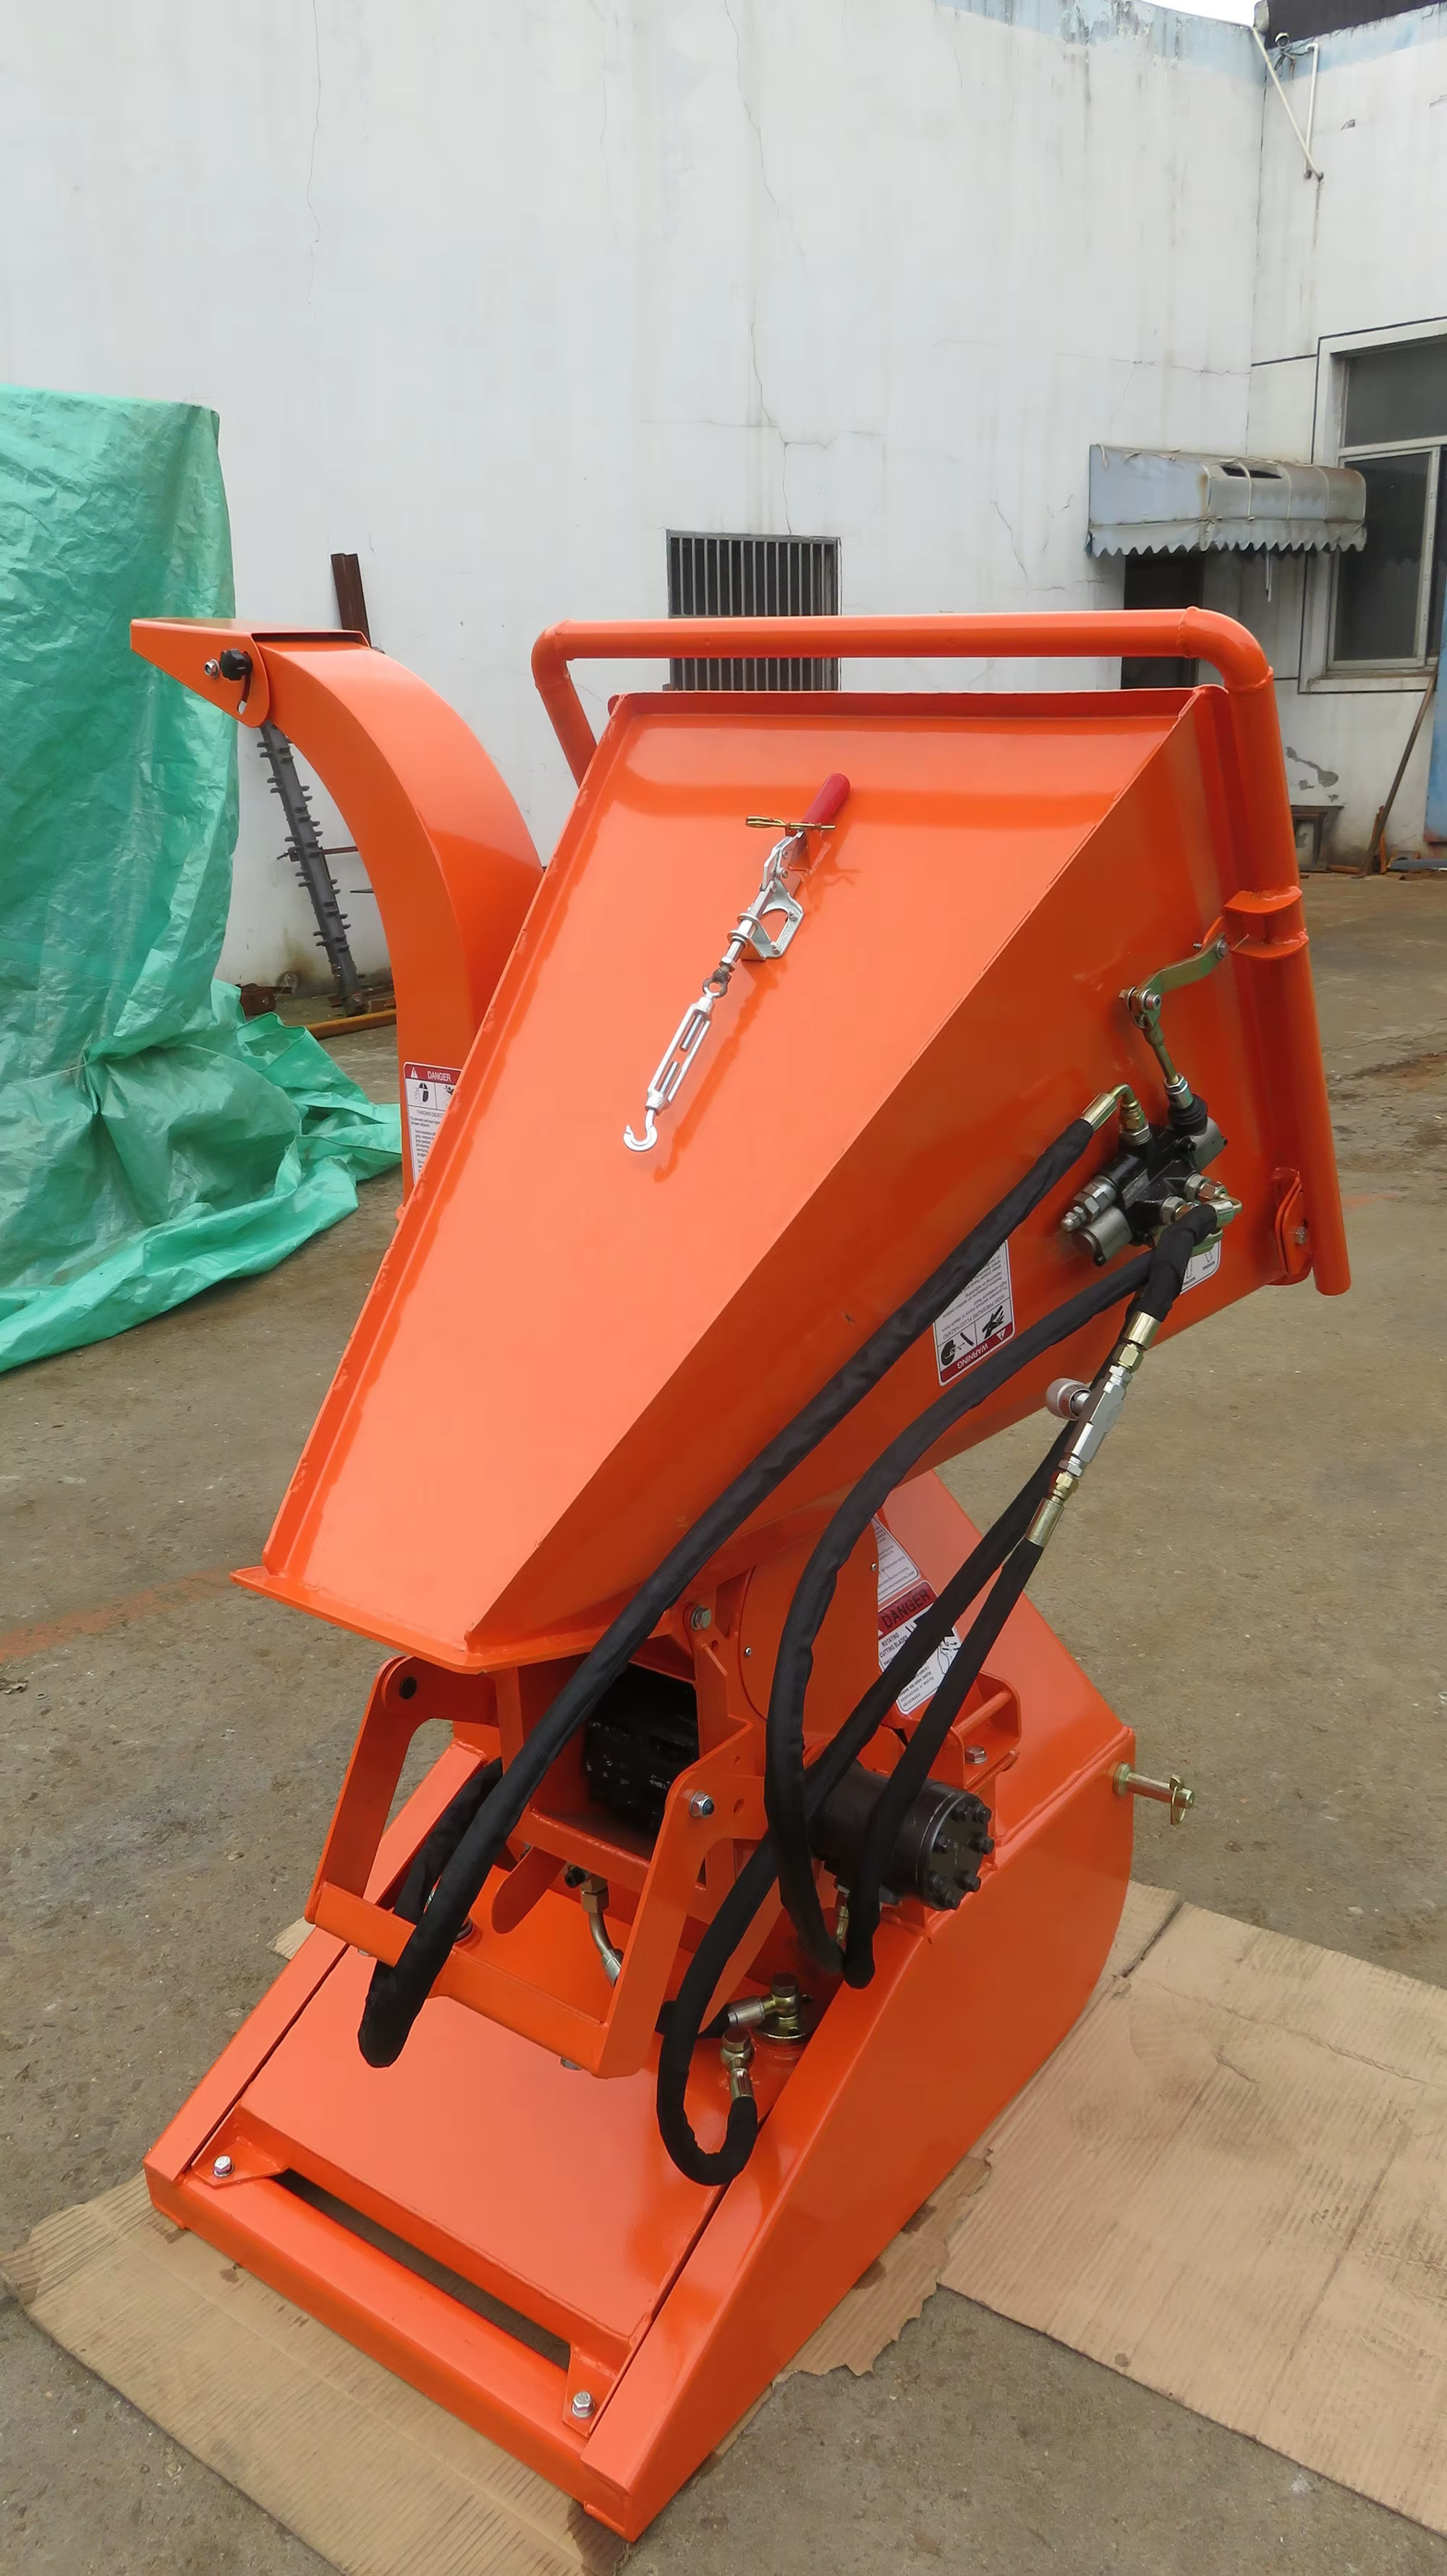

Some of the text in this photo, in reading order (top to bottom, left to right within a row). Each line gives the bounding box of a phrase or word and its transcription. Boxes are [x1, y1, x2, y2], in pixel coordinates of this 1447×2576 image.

[427, 1070, 451, 1082] DANGER
[972, 1301, 993, 1319] PRESSURE
[959, 1316, 972, 1328] FLUID
[942, 1325, 959, 1340] HAZARD
[956, 1342, 988, 1369] WARNING
[882, 1589, 931, 1629] DANGER
[881, 1632, 899, 1647] ROTATING
[880, 1644, 896, 1658] CUTTING
